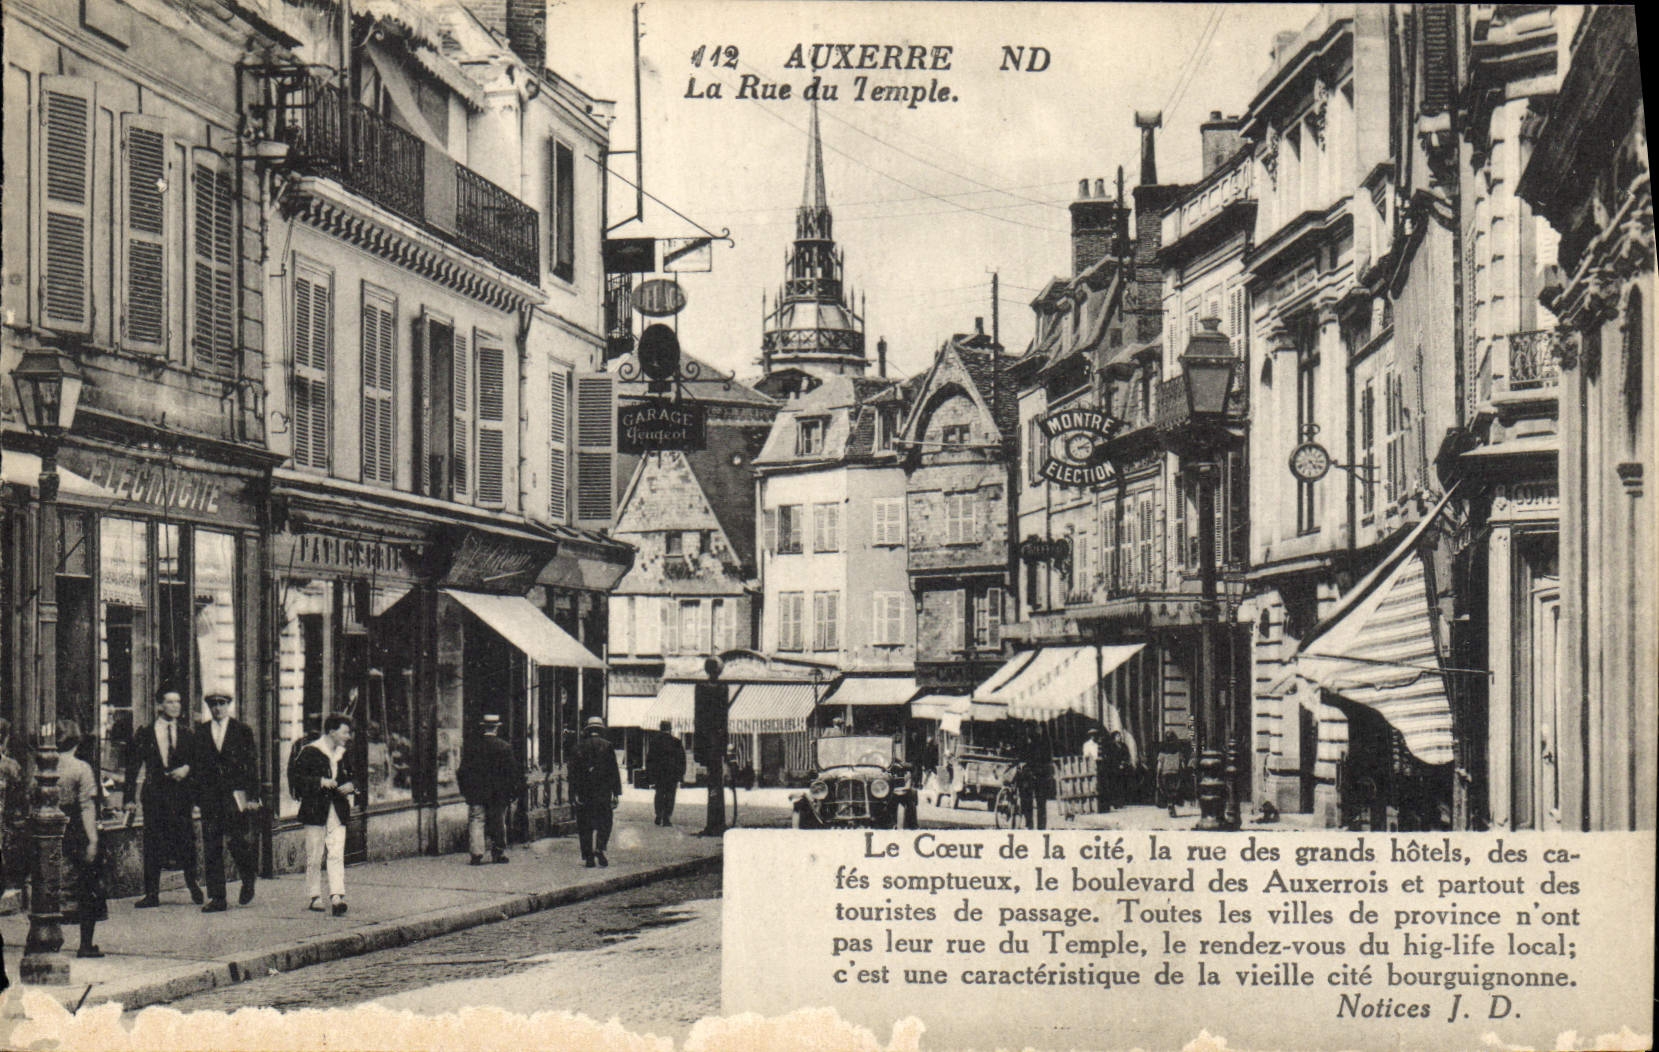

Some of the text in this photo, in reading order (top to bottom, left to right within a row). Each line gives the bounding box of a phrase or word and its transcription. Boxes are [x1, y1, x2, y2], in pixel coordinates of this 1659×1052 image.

[622, 408, 693, 426] GARAGE
[1047, 412, 1115, 435] MONTRE
[626, 426, 687, 444] Peugeot
[1046, 461, 1116, 483] ELECTION
[300, 534, 404, 573] PATISSERIE
